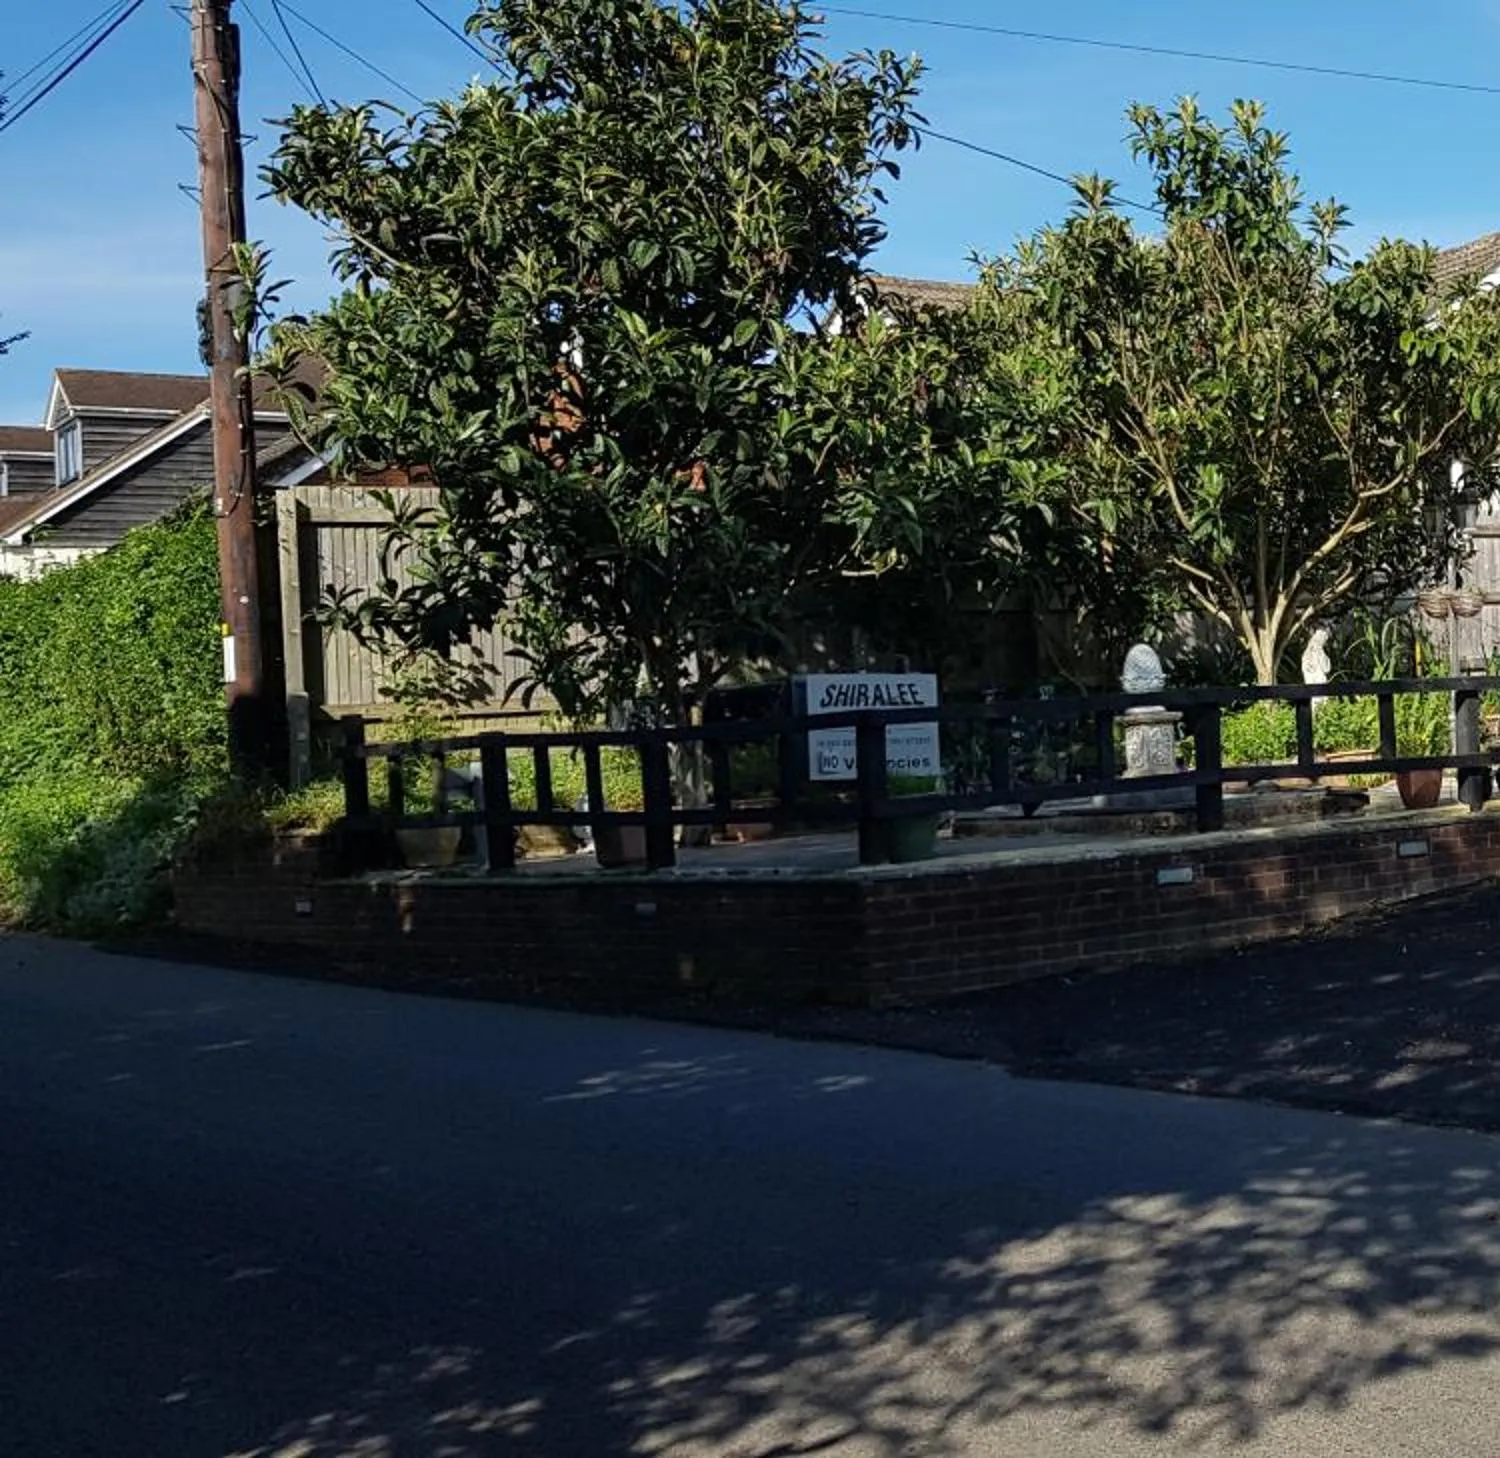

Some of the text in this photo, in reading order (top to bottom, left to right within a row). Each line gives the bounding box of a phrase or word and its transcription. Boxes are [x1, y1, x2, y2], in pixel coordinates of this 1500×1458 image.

[820, 683, 925, 708] SHIRALEE
[823, 756, 931, 770] NO Vncies
